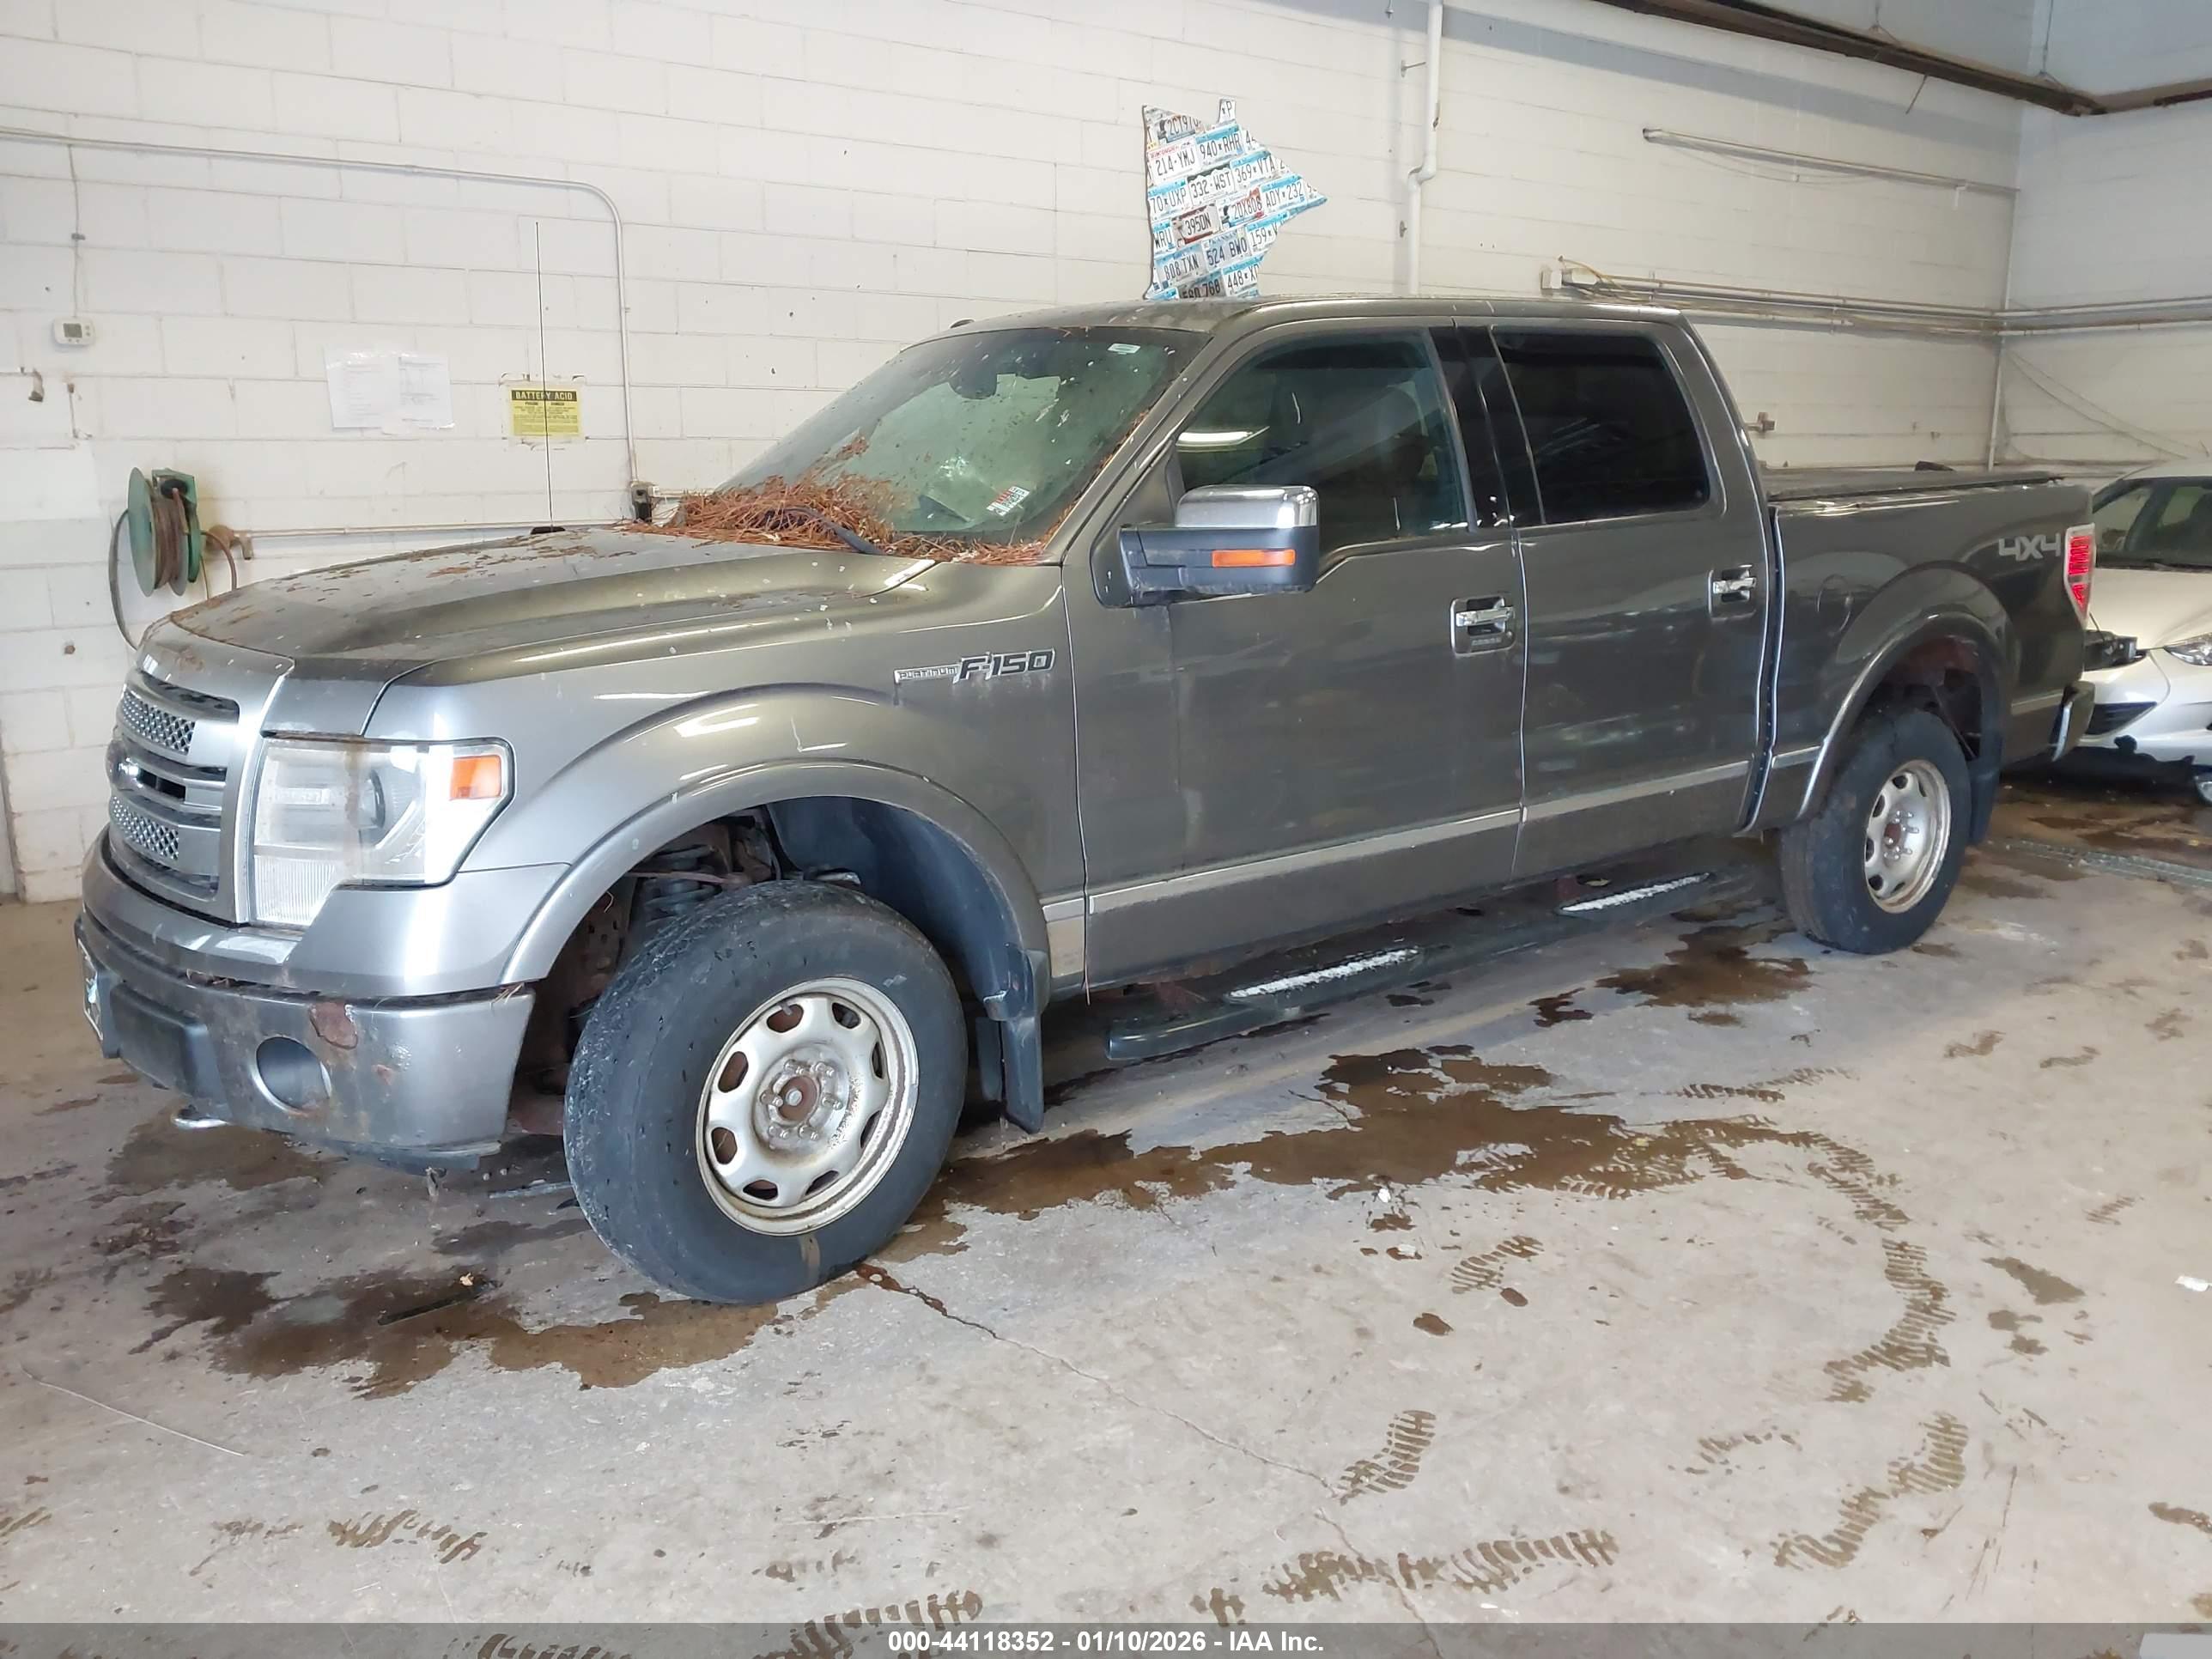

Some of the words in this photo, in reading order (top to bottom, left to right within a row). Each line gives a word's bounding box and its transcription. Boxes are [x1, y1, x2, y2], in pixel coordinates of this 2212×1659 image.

[1206, 246, 1224, 266] 524
[515, 392, 550, 400] BATTERY
[555, 392, 573, 401] ACID
